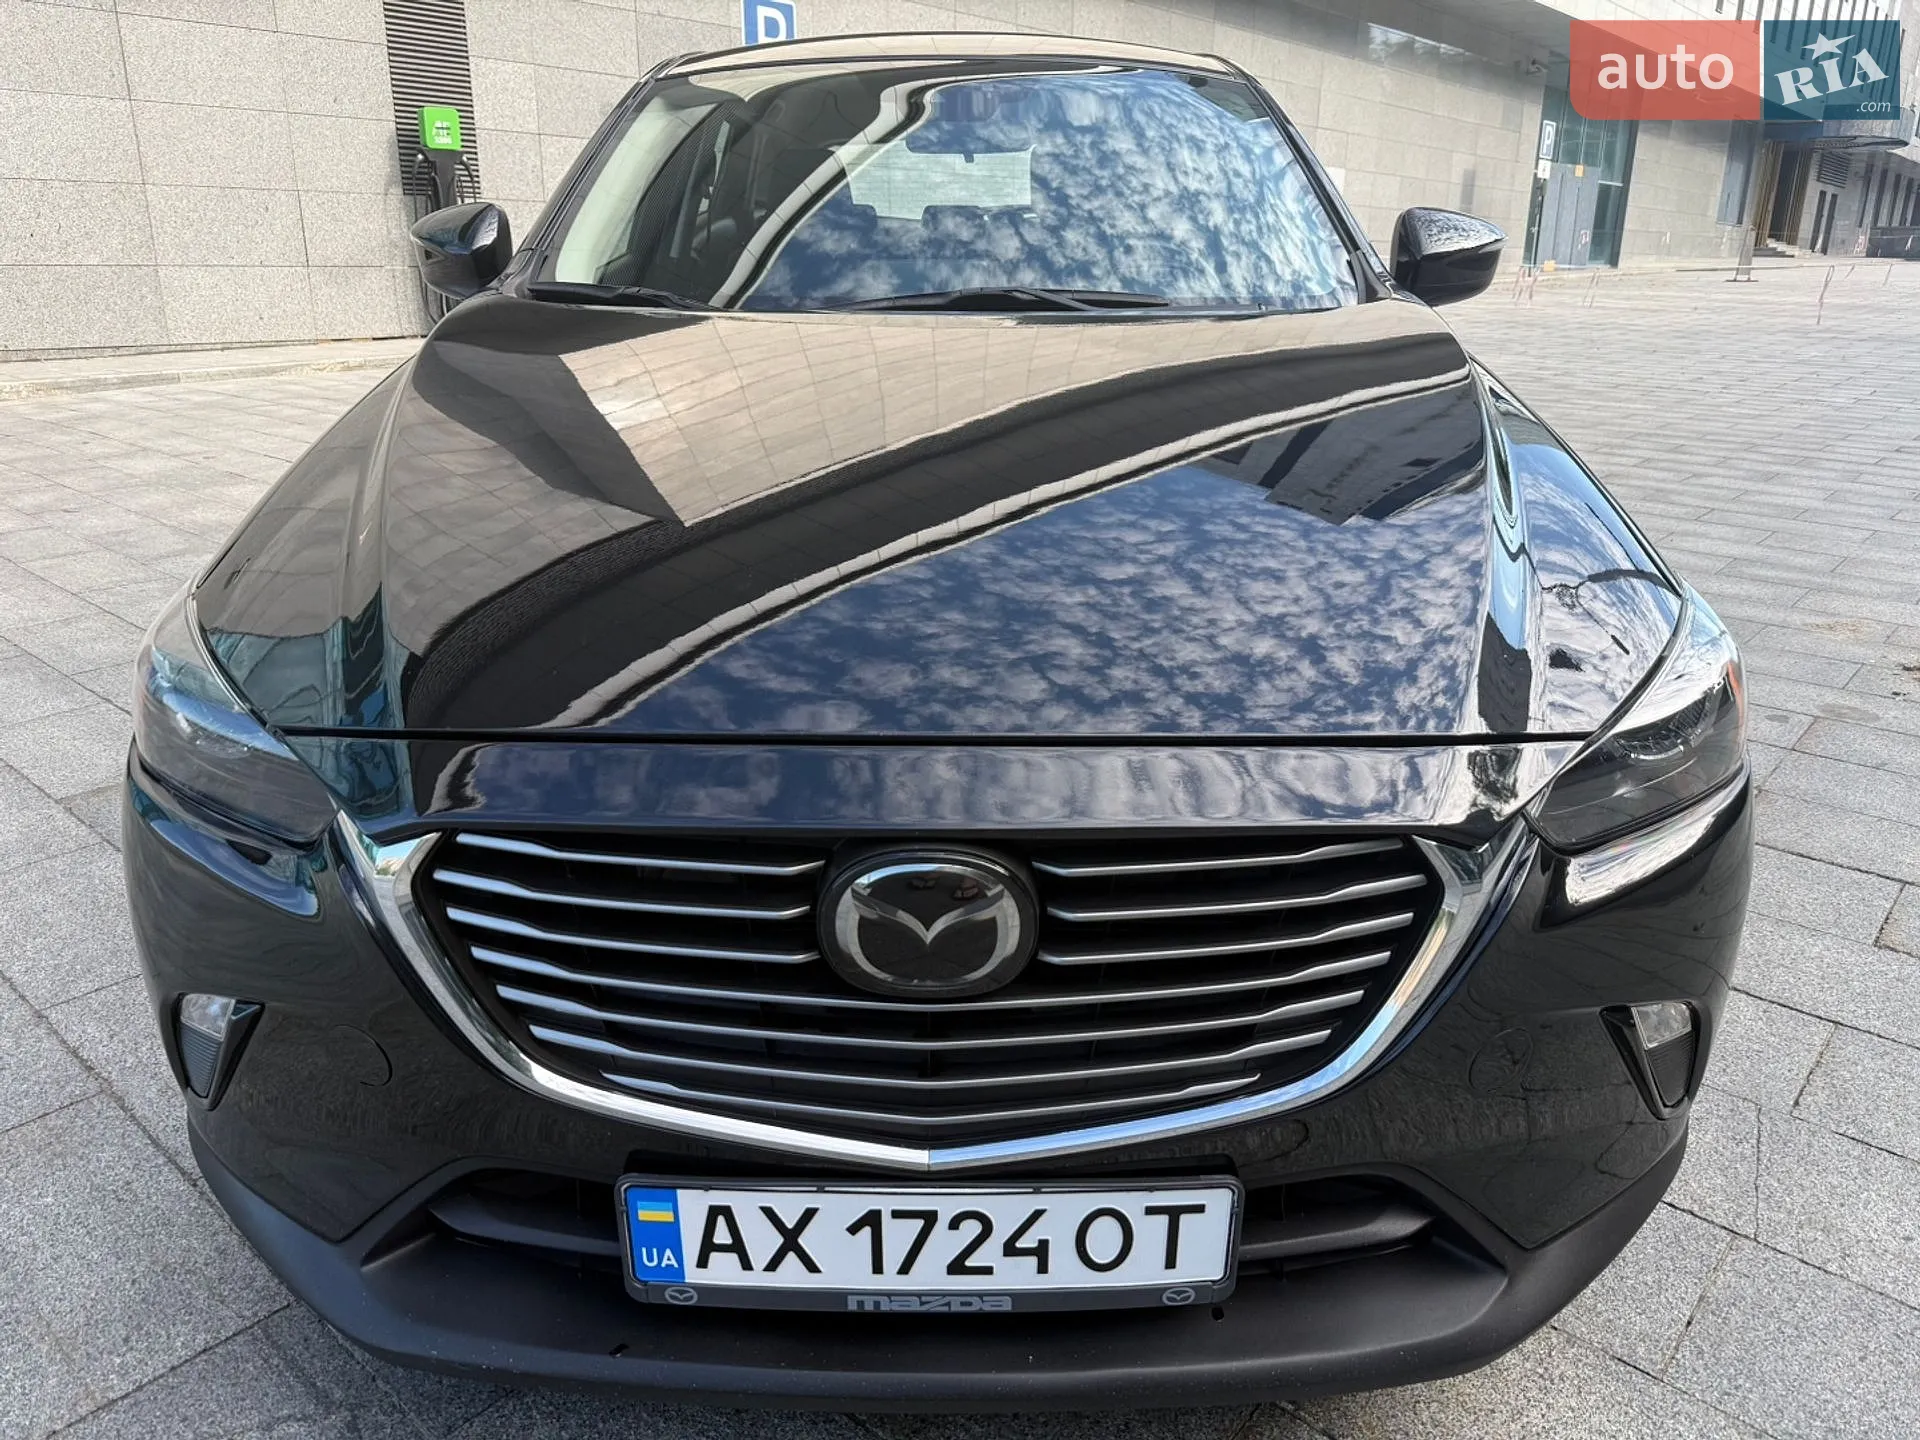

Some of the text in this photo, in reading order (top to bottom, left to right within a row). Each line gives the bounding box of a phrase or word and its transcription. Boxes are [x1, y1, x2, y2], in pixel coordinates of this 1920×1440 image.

[1543, 124, 1553, 154] P
[696, 1203, 1206, 1275] AX 1724 OT
[641, 1247, 679, 1268] UA
